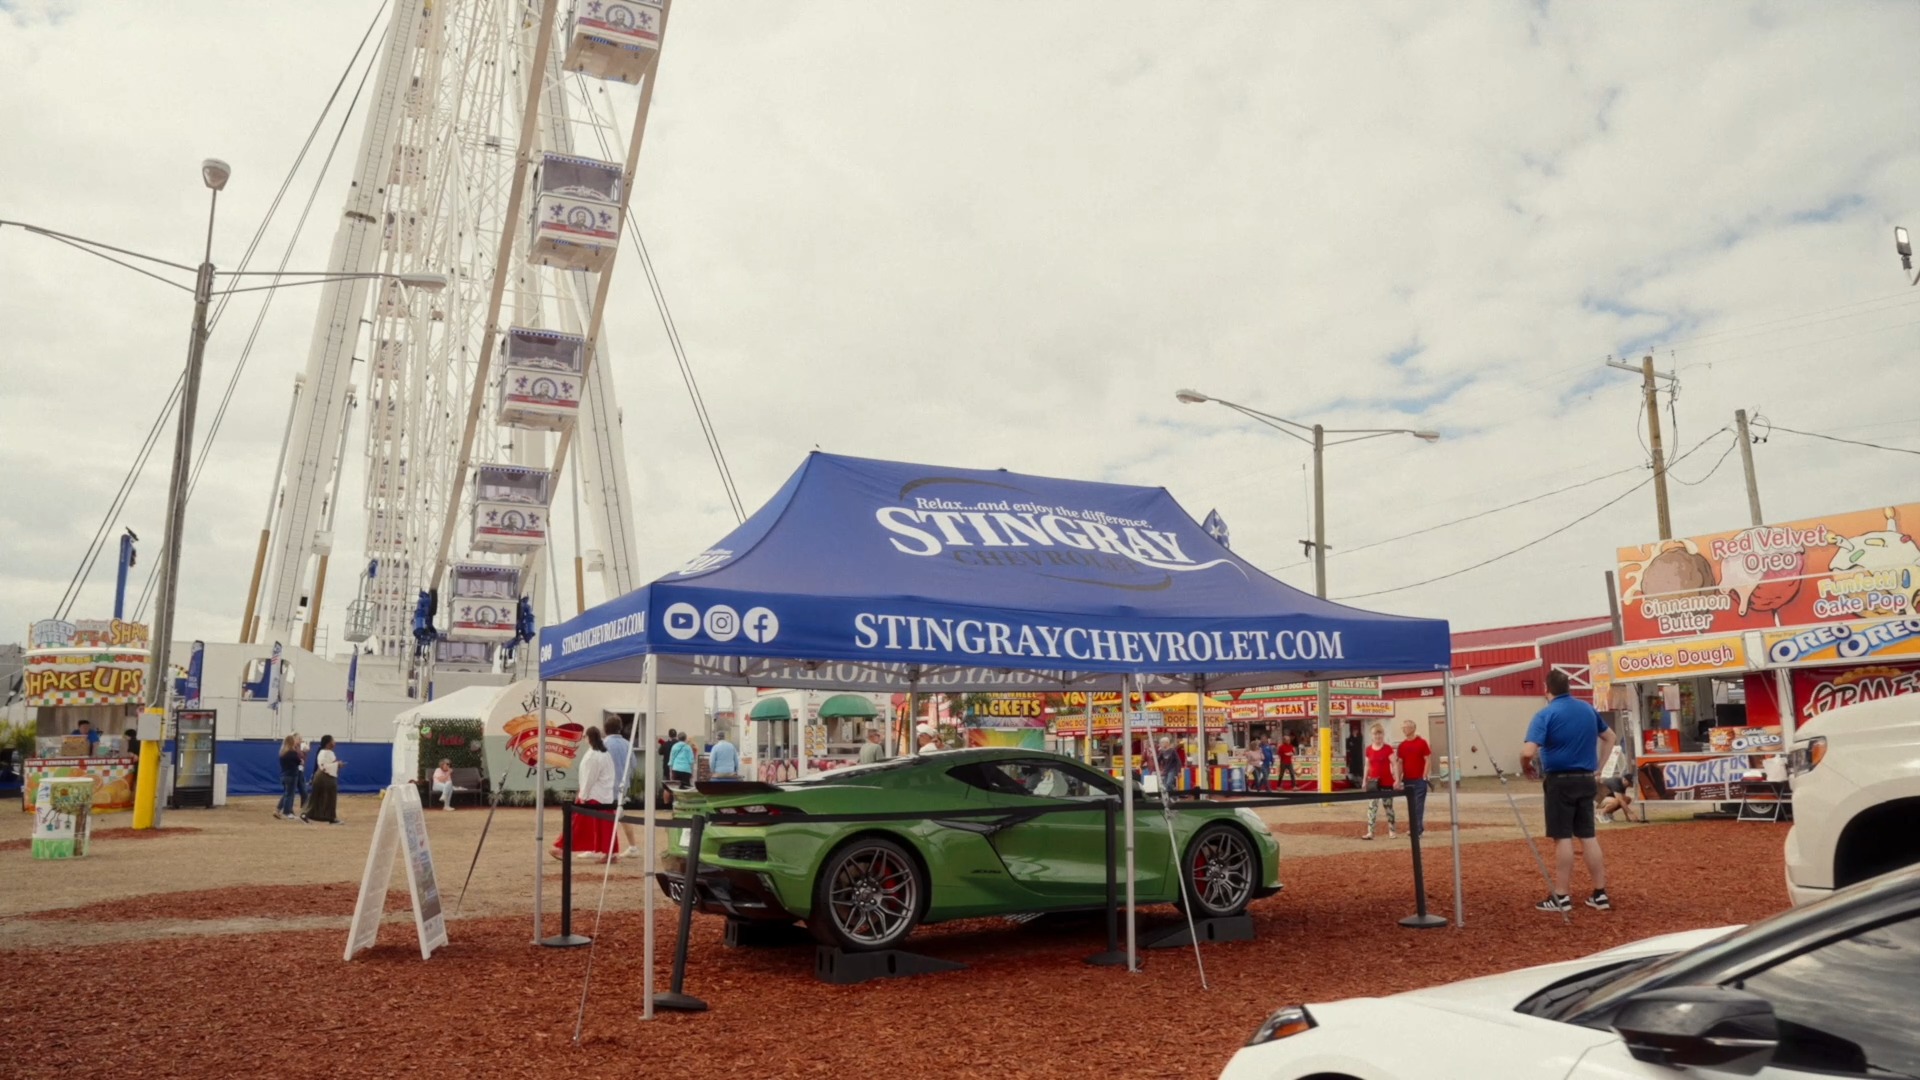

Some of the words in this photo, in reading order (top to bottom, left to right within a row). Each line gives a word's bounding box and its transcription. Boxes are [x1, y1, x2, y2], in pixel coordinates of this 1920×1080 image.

[1012, 501, 1054, 516] enjoy
[1055, 506, 1080, 519] the
[1081, 511, 1153, 530] difference.
[875, 506, 1196, 565] STINGRAY
[1710, 537, 1752, 559] Red
[1756, 524, 1827, 548] Velvet
[953, 548, 1143, 574] CHEVROLET
[1744, 552, 1796, 572] Oreo
[1818, 570, 1897, 597] Funfetti
[1641, 594, 1730, 618] Cinnamon
[1814, 595, 1864, 617] Cake
[1868, 591, 1906, 613] Pop
[561, 611, 646, 656] STINGRAYCHEVROLET.COM
[1659, 613, 1713, 634] Butter
[854, 612, 1344, 663] STINGRAYCHEVROLET.COM
[1770, 625, 1852, 663] OREO
[1838, 619, 1920, 659] OREO
[1619, 653, 1674, 672] Cookie
[1677, 645, 1734, 665] Dough
[1275, 704, 1303, 714] STEAK
[1310, 701, 1346, 711] FES
[1356, 701, 1390, 709] SAUSAGE
[1167, 715, 1186, 724] DOG
[1731, 735, 1781, 750] OREO
[526, 767, 566, 782] PES
